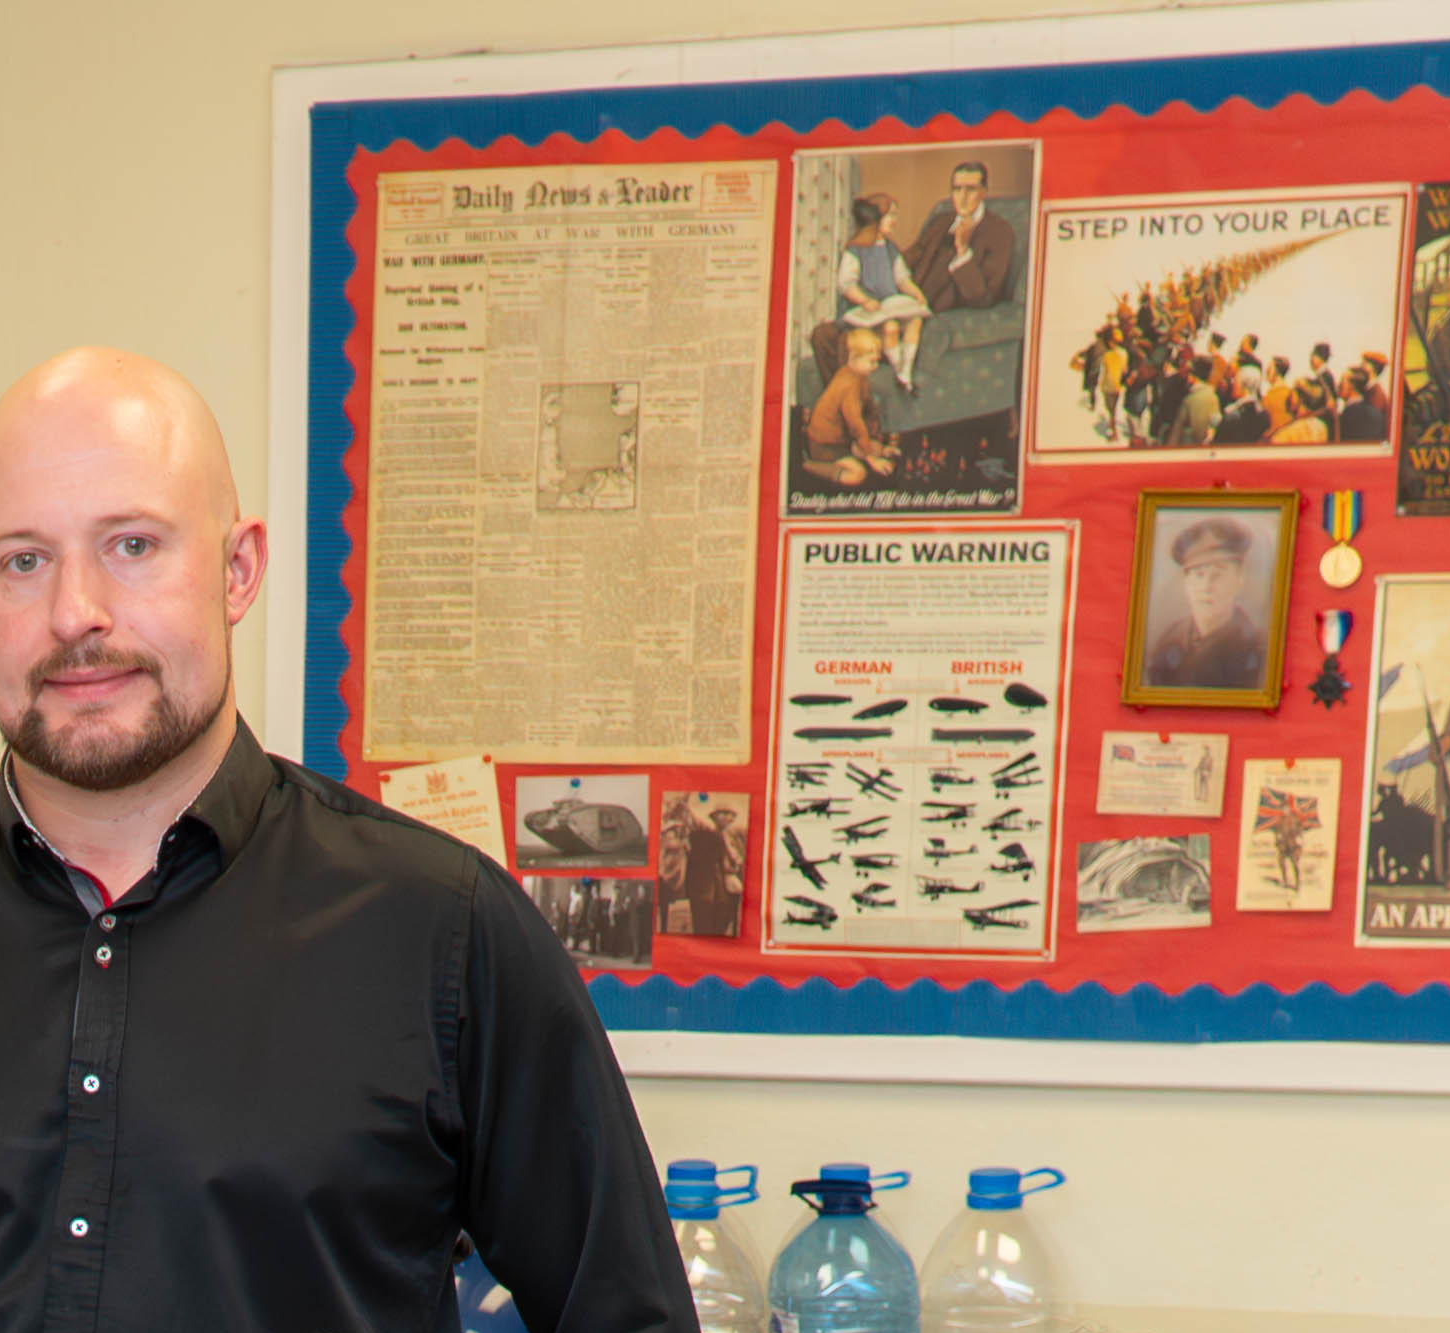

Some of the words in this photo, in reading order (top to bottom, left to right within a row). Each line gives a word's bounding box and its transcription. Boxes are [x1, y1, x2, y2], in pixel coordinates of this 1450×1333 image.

[452, 186, 514, 212] Daily
[524, 181, 590, 211] News
[615, 176, 694, 207] Leader
[405, 232, 450, 245] GREAT
[464, 230, 519, 243] BRITAIN
[533, 227, 551, 240] AT
[566, 226, 599, 239] WAR
[616, 225, 654, 238] WITH
[668, 222, 738, 237] GERMANY
[1057, 216, 1128, 240] STEP
[1139, 213, 1203, 237] INTO
[1213, 210, 1288, 234] YOUR
[1300, 205, 1391, 230] PLACE
[804, 543, 902, 563] PUBLIC
[912, 541, 1050, 562] WARNING
[815, 660, 892, 675] GERMAN
[951, 660, 1023, 674] BRITISH
[1370, 903, 1406, 928] AN
